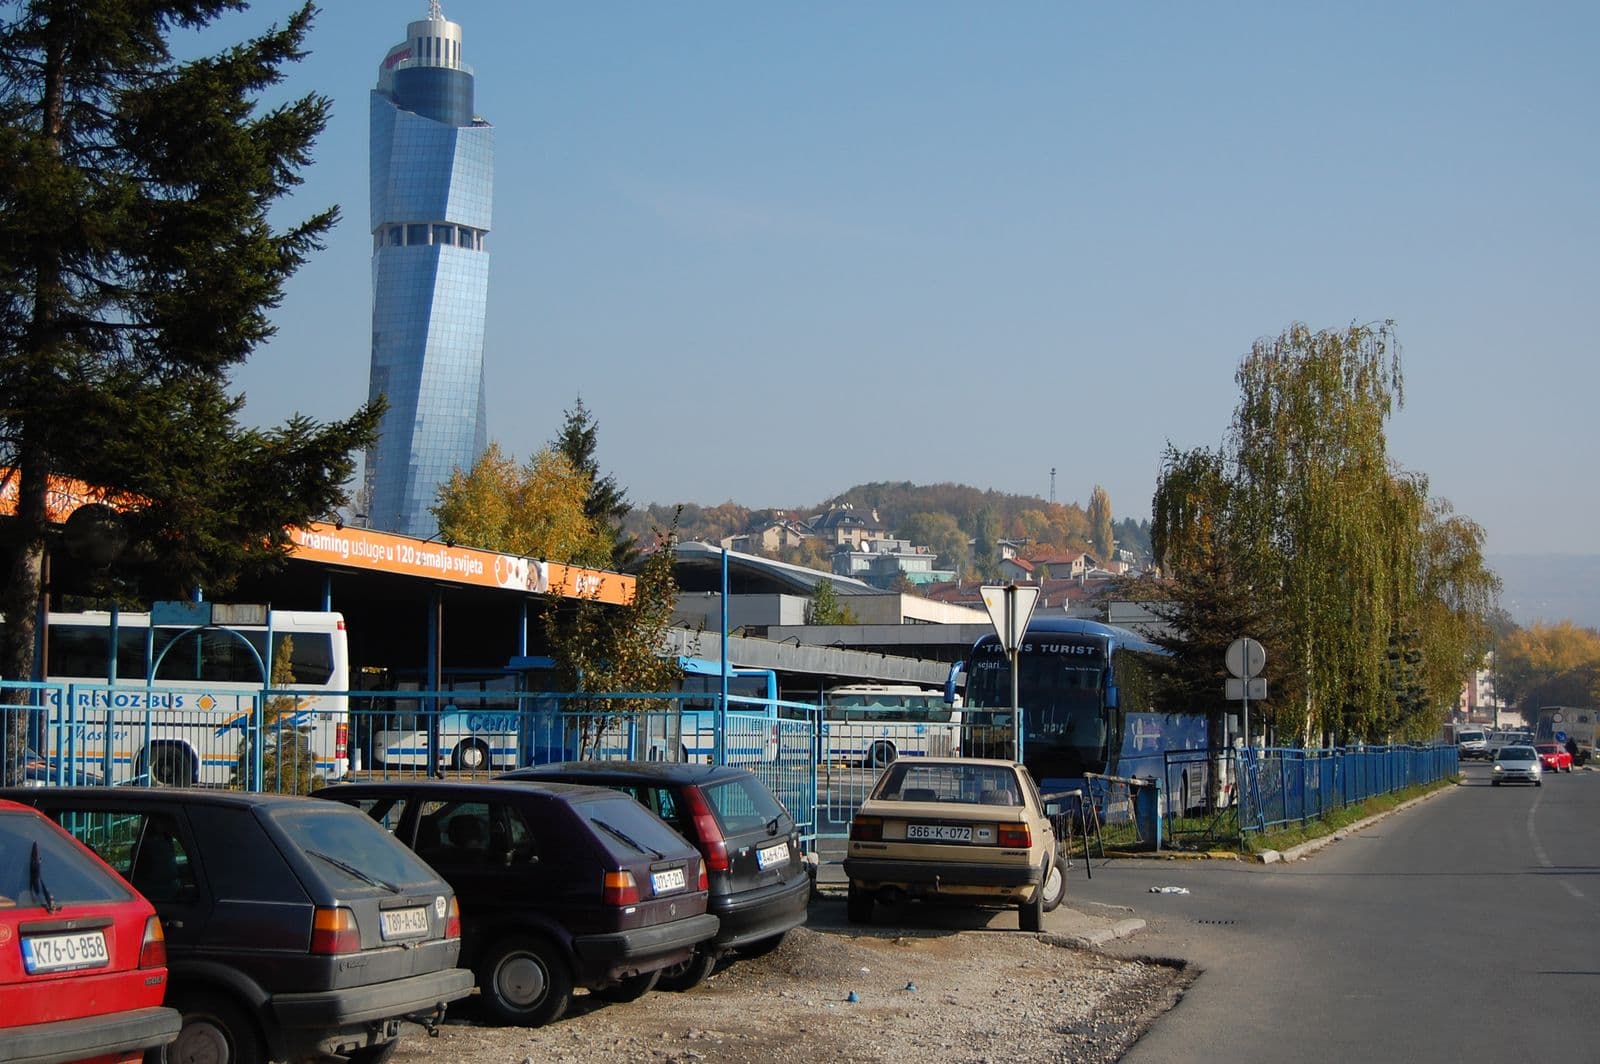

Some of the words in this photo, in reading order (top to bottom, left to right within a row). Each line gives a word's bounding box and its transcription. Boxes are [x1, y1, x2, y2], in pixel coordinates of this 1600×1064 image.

[351, 538, 385, 563] usluge
[386, 547, 393, 560] u
[396, 545, 414, 564] 120
[415, 551, 452, 573] zemalja
[454, 555, 483, 577] svijeta
[986, 644, 1033, 653] TRS
[1040, 644, 1095, 655] TURIST
[910, 826, 969, 840] 366-K-072
